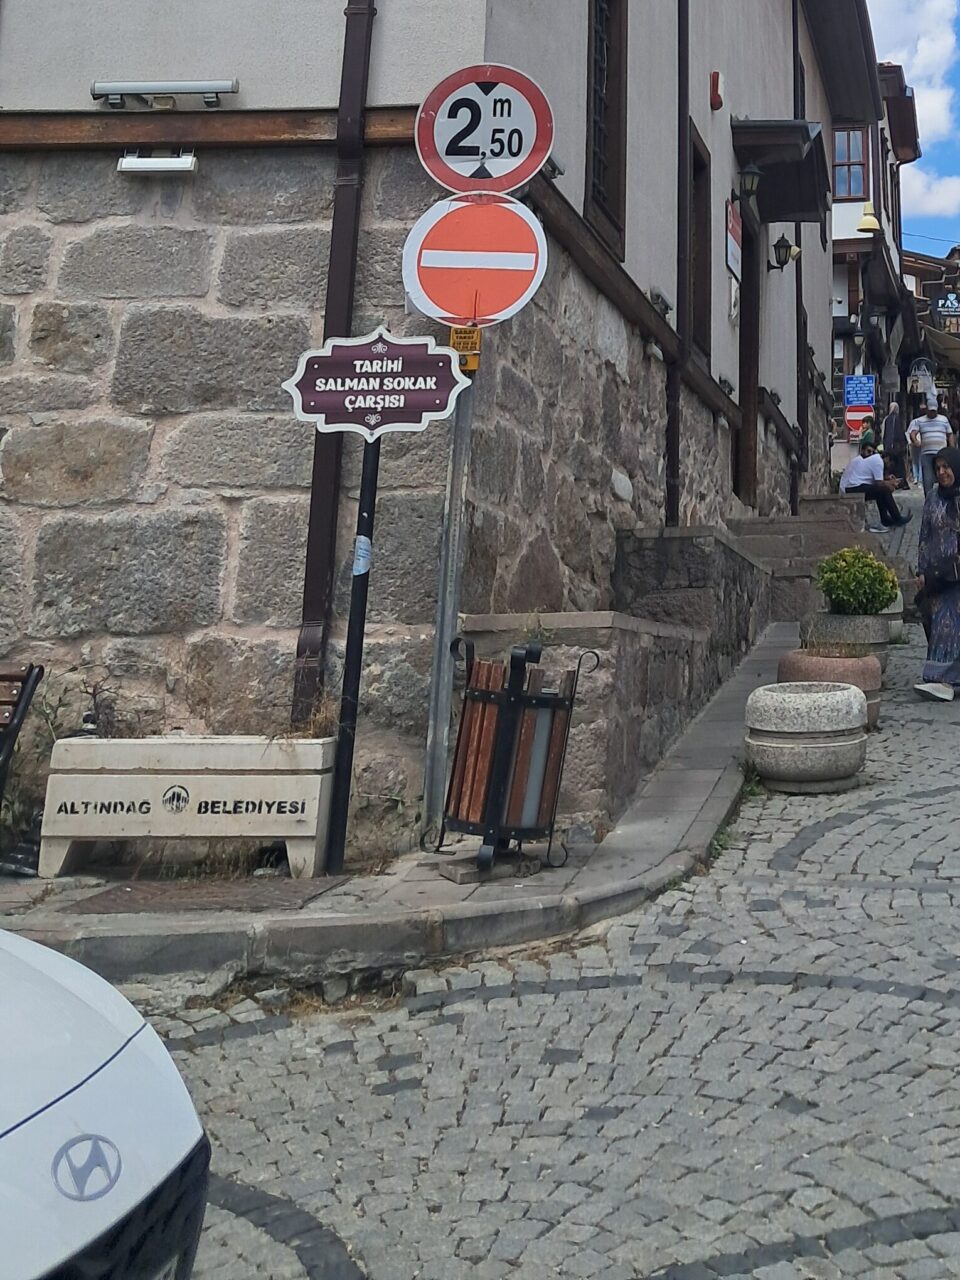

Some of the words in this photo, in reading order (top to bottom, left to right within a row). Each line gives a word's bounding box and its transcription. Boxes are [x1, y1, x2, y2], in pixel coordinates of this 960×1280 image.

[353, 356, 403, 373] TARİHİ
[315, 377, 380, 391] SALMAN
[383, 376, 437, 390] SOKAK
[344, 394, 405, 412] ÇARŞISI
[197, 799, 306, 815] BELEDİYESİ
